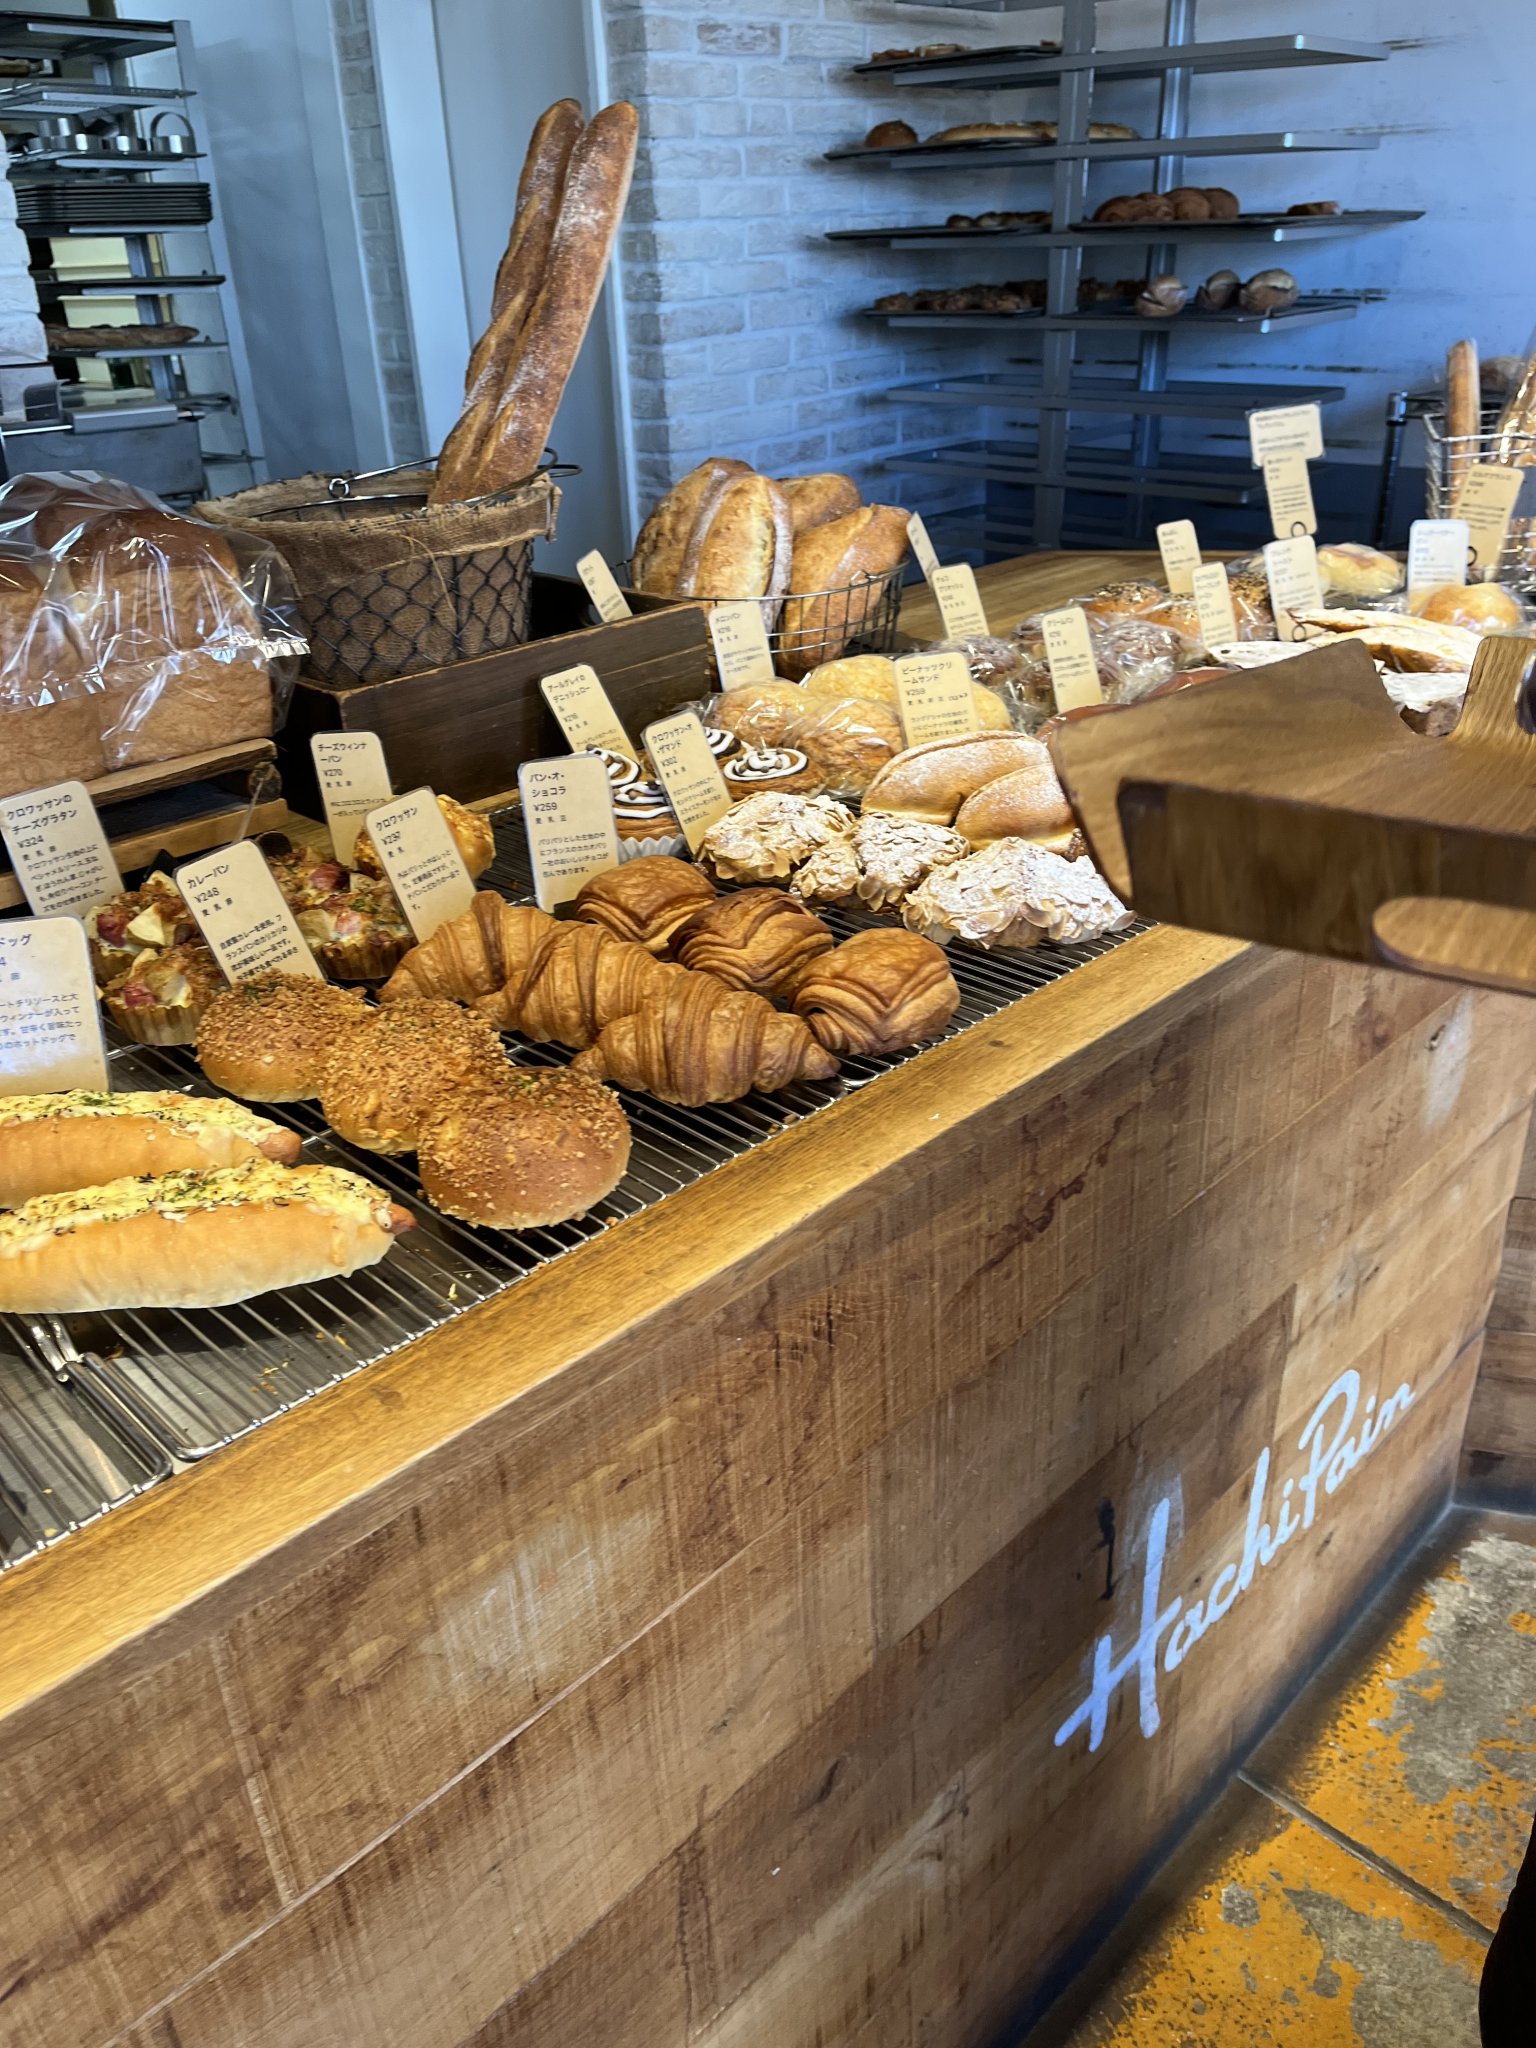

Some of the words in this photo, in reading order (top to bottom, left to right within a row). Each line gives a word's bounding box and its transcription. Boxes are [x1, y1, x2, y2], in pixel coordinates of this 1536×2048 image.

[318, 743, 367, 752] チーズウィンナ
[530, 772, 564, 782] パン・オ・
[532, 786, 566, 797] ショコラ
[7, 794, 72, 820] クロワッサンの
[533, 802, 557, 811] ¥259
[12, 810, 77, 835] チーズグラタン
[376, 808, 417, 831] クロワッサン
[17, 835, 44, 848] ¥324
[187, 865, 229, 889] カレーパン
[194, 887, 219, 903] ¥248
